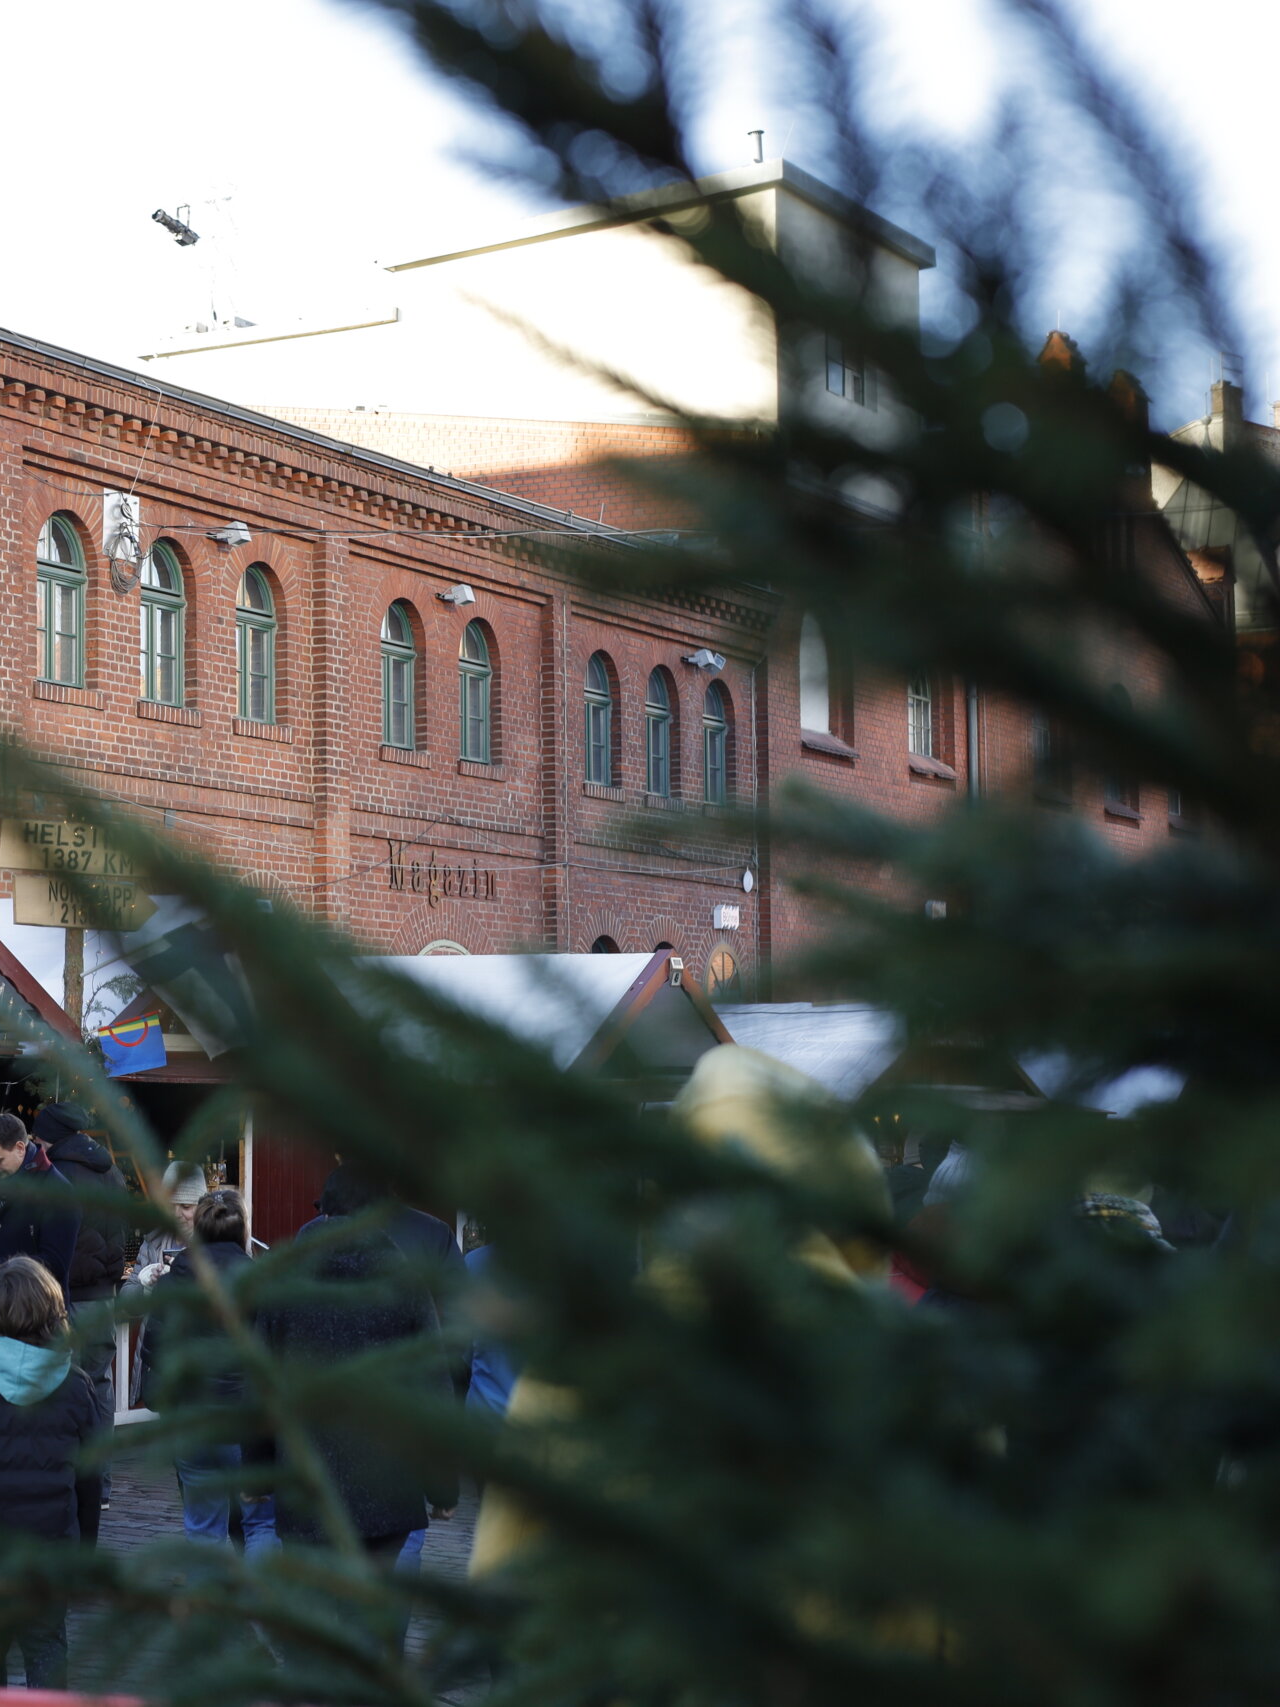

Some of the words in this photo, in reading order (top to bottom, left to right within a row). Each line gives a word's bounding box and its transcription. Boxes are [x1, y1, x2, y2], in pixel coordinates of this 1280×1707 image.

[24, 823, 119, 849] HELSIN
[42, 847, 92, 871] 1387
[104, 853, 134, 874] KM
[387, 839, 497, 909] Magazin
[48, 880, 132, 908] NORAPP
